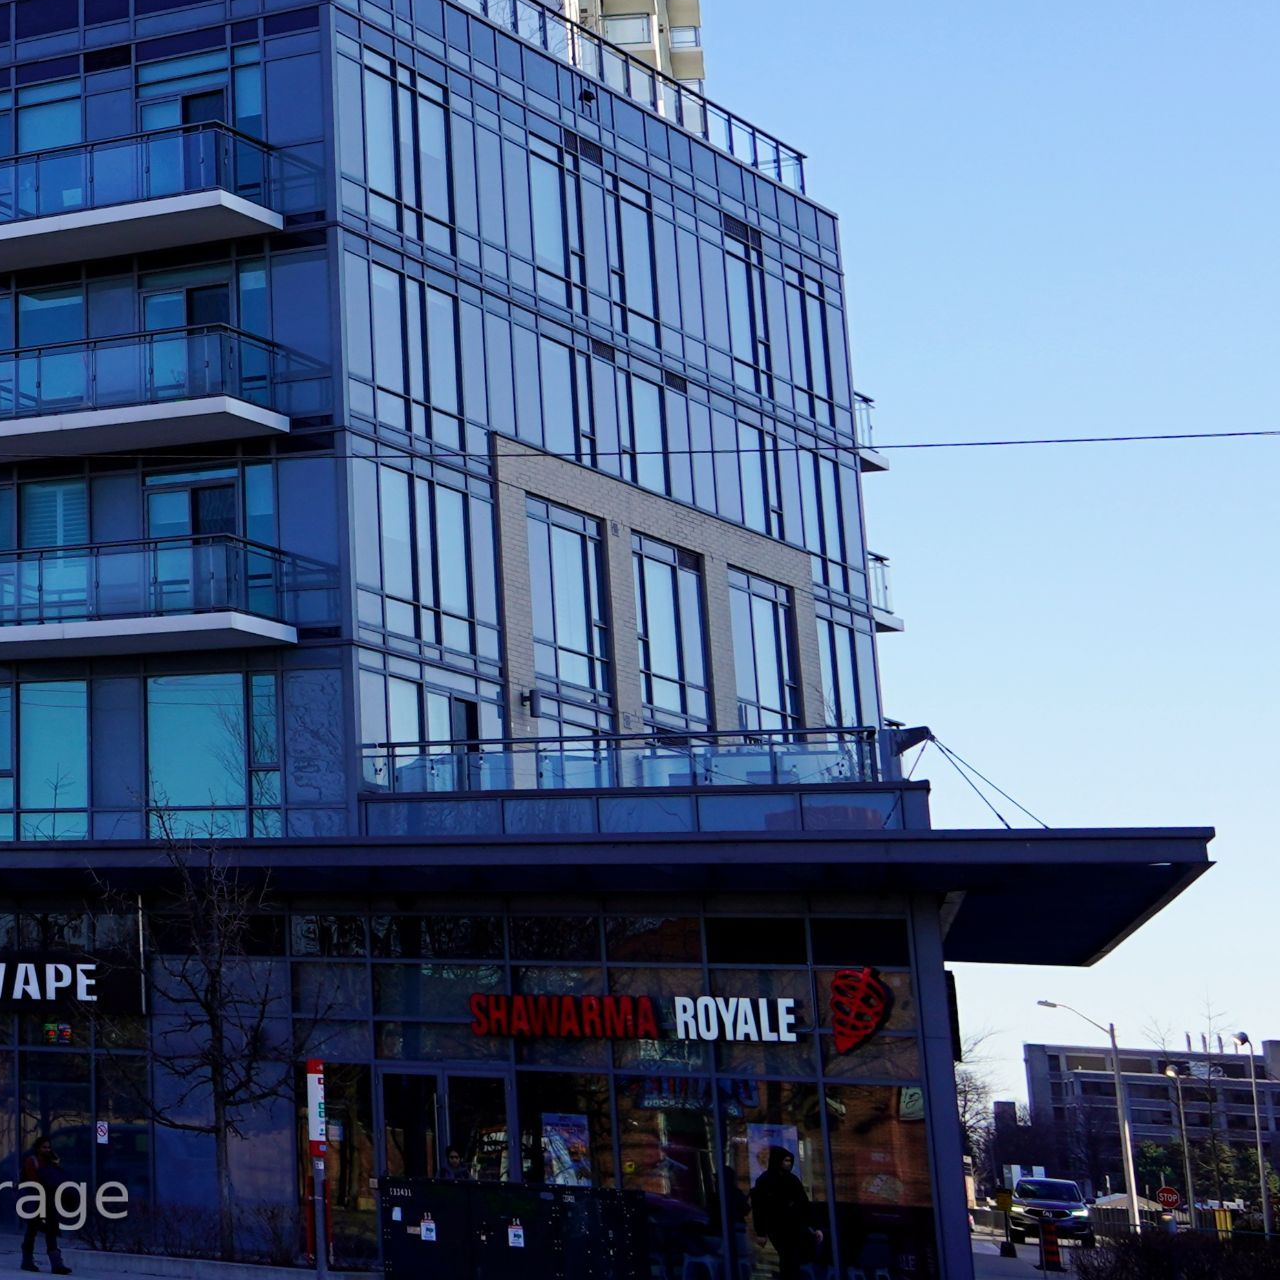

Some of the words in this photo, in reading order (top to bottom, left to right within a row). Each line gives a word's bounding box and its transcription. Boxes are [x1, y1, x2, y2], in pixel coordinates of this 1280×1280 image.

[469, 992, 660, 1041] SHAWARMA
[674, 996, 798, 1043] ROYALE
[1158, 1192, 1178, 1202] STOP
